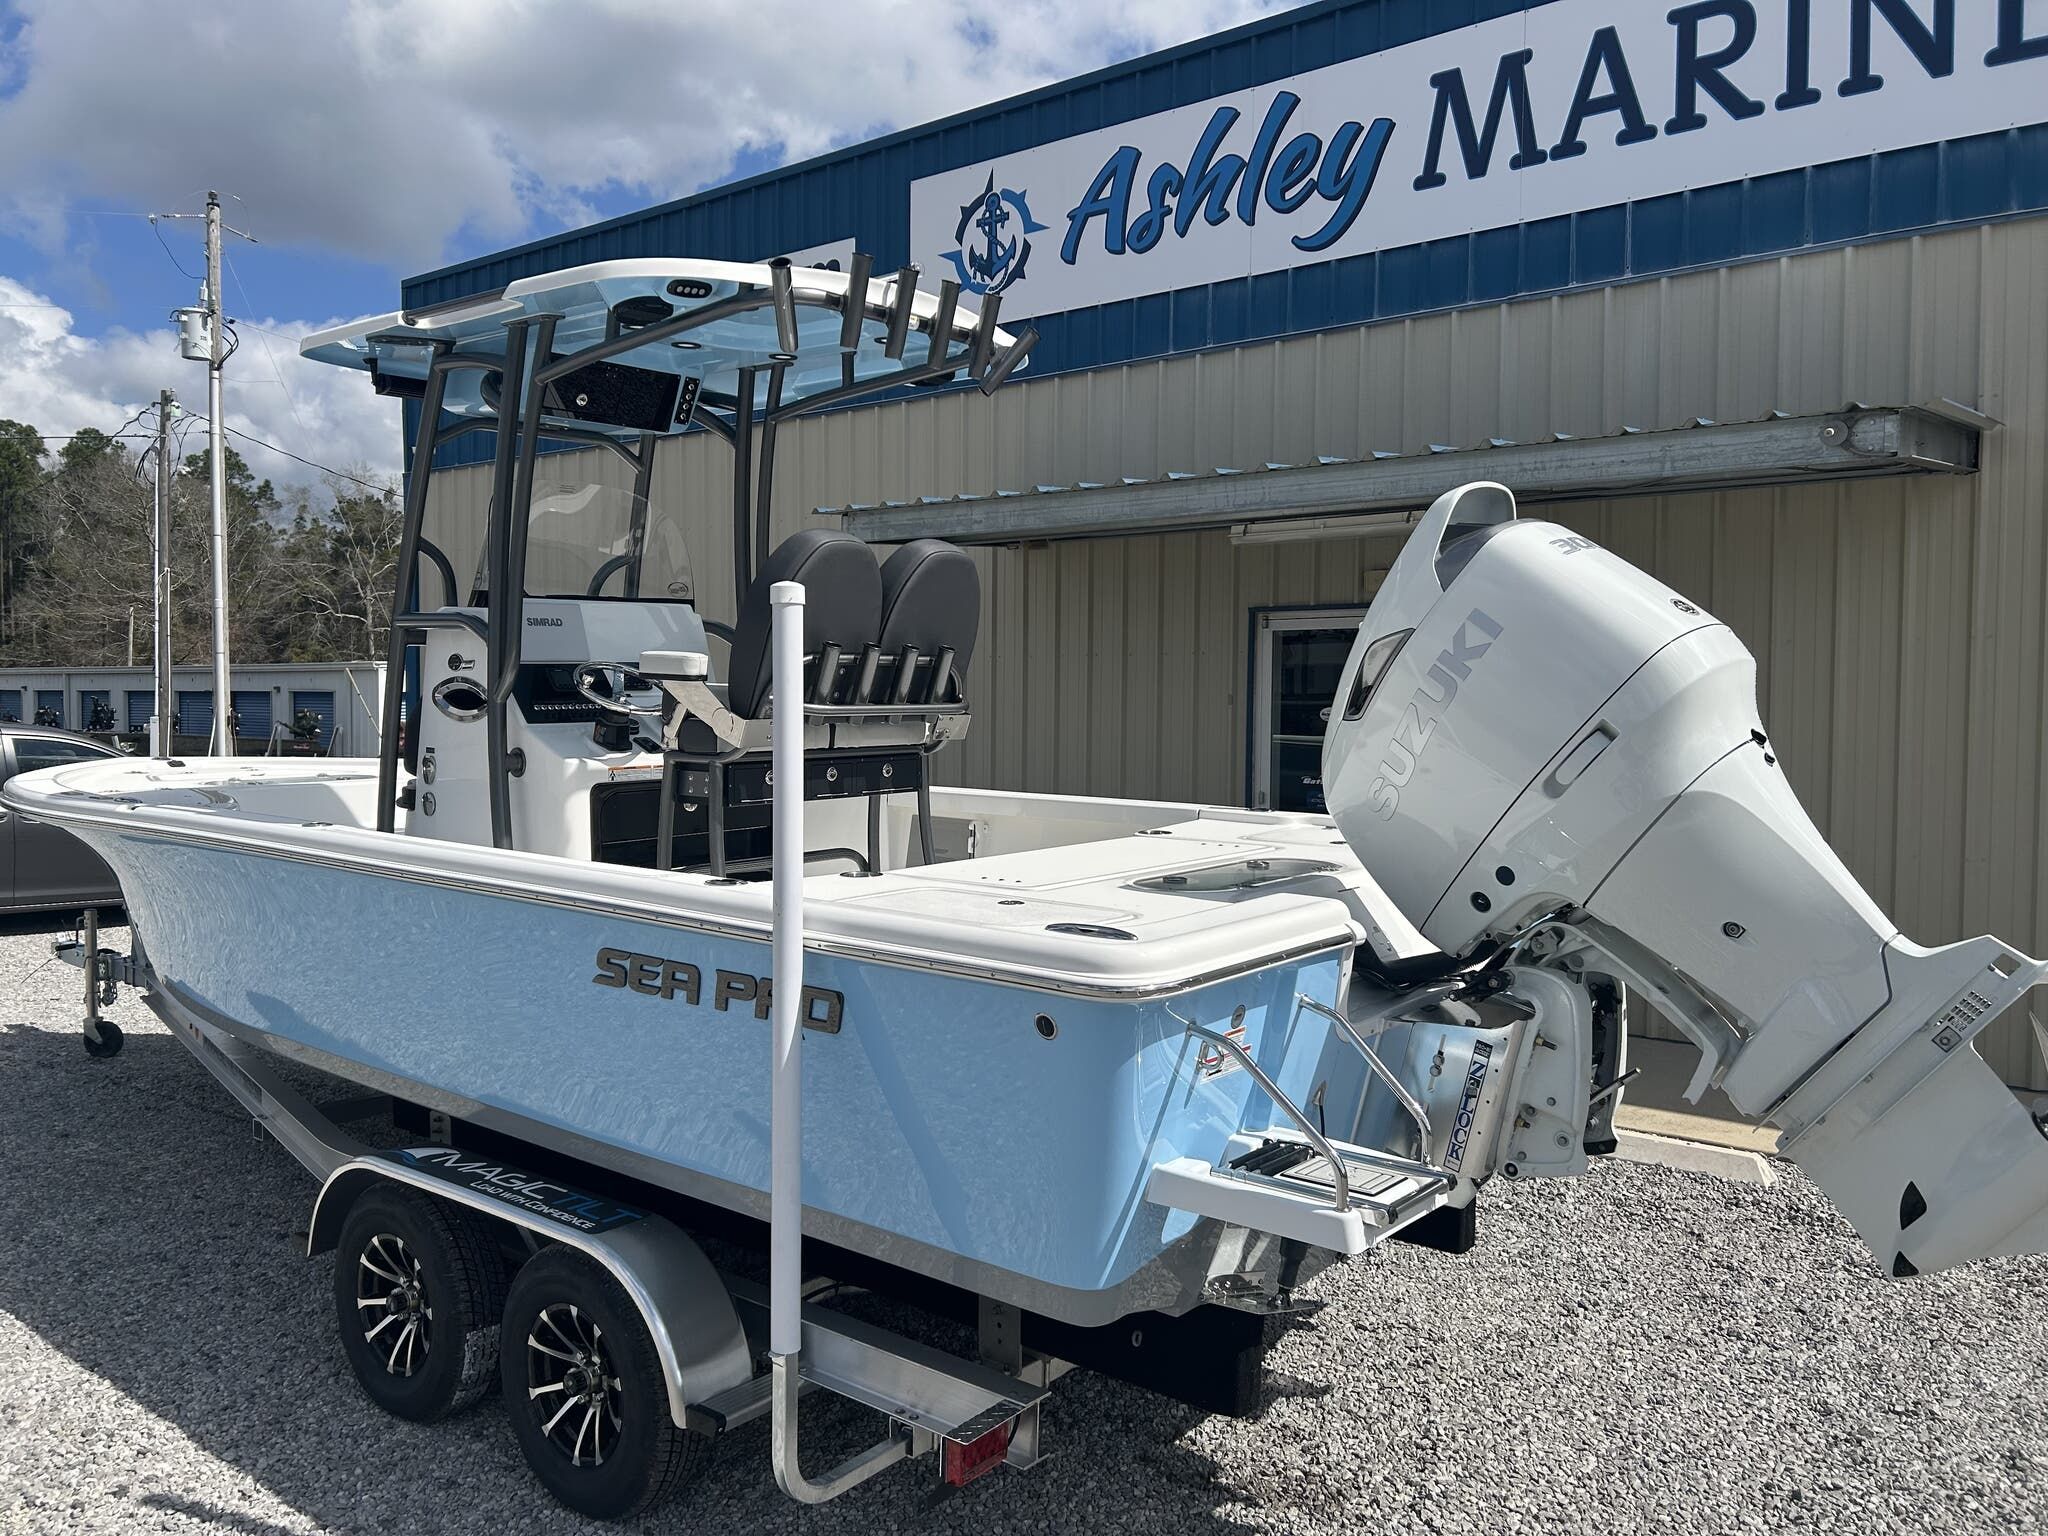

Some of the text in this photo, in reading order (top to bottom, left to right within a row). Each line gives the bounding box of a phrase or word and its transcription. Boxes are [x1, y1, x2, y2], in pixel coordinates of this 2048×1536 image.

[1060, 0, 2048, 265] Ashley MARIN
[526, 617, 563, 627] SIMRAD
[1367, 607, 1504, 822] SUZUKI
[592, 947, 701, 1006] SEA
